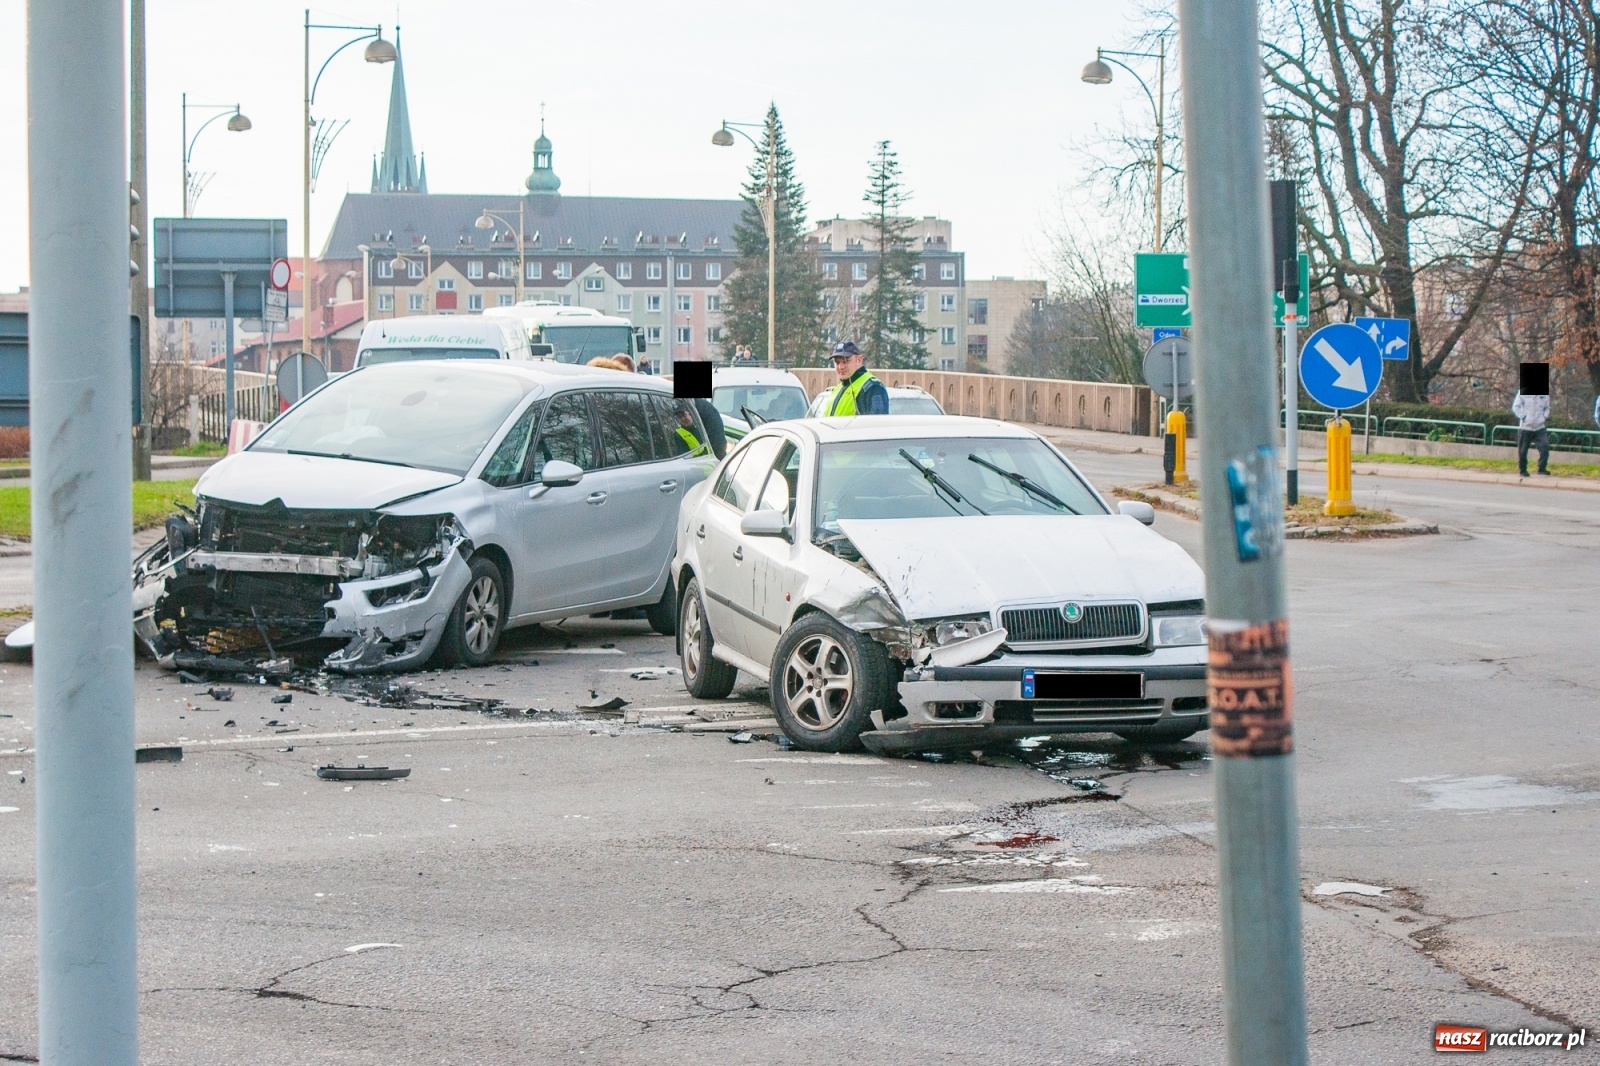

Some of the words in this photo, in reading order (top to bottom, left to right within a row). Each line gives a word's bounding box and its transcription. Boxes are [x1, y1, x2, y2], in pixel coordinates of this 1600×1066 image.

[1152, 296, 1185, 304] Dworzec
[387, 335, 421, 344] Woda
[424, 334, 445, 343] dla
[448, 335, 486, 345] Ciebie
[1025, 685, 1033, 693] PL
